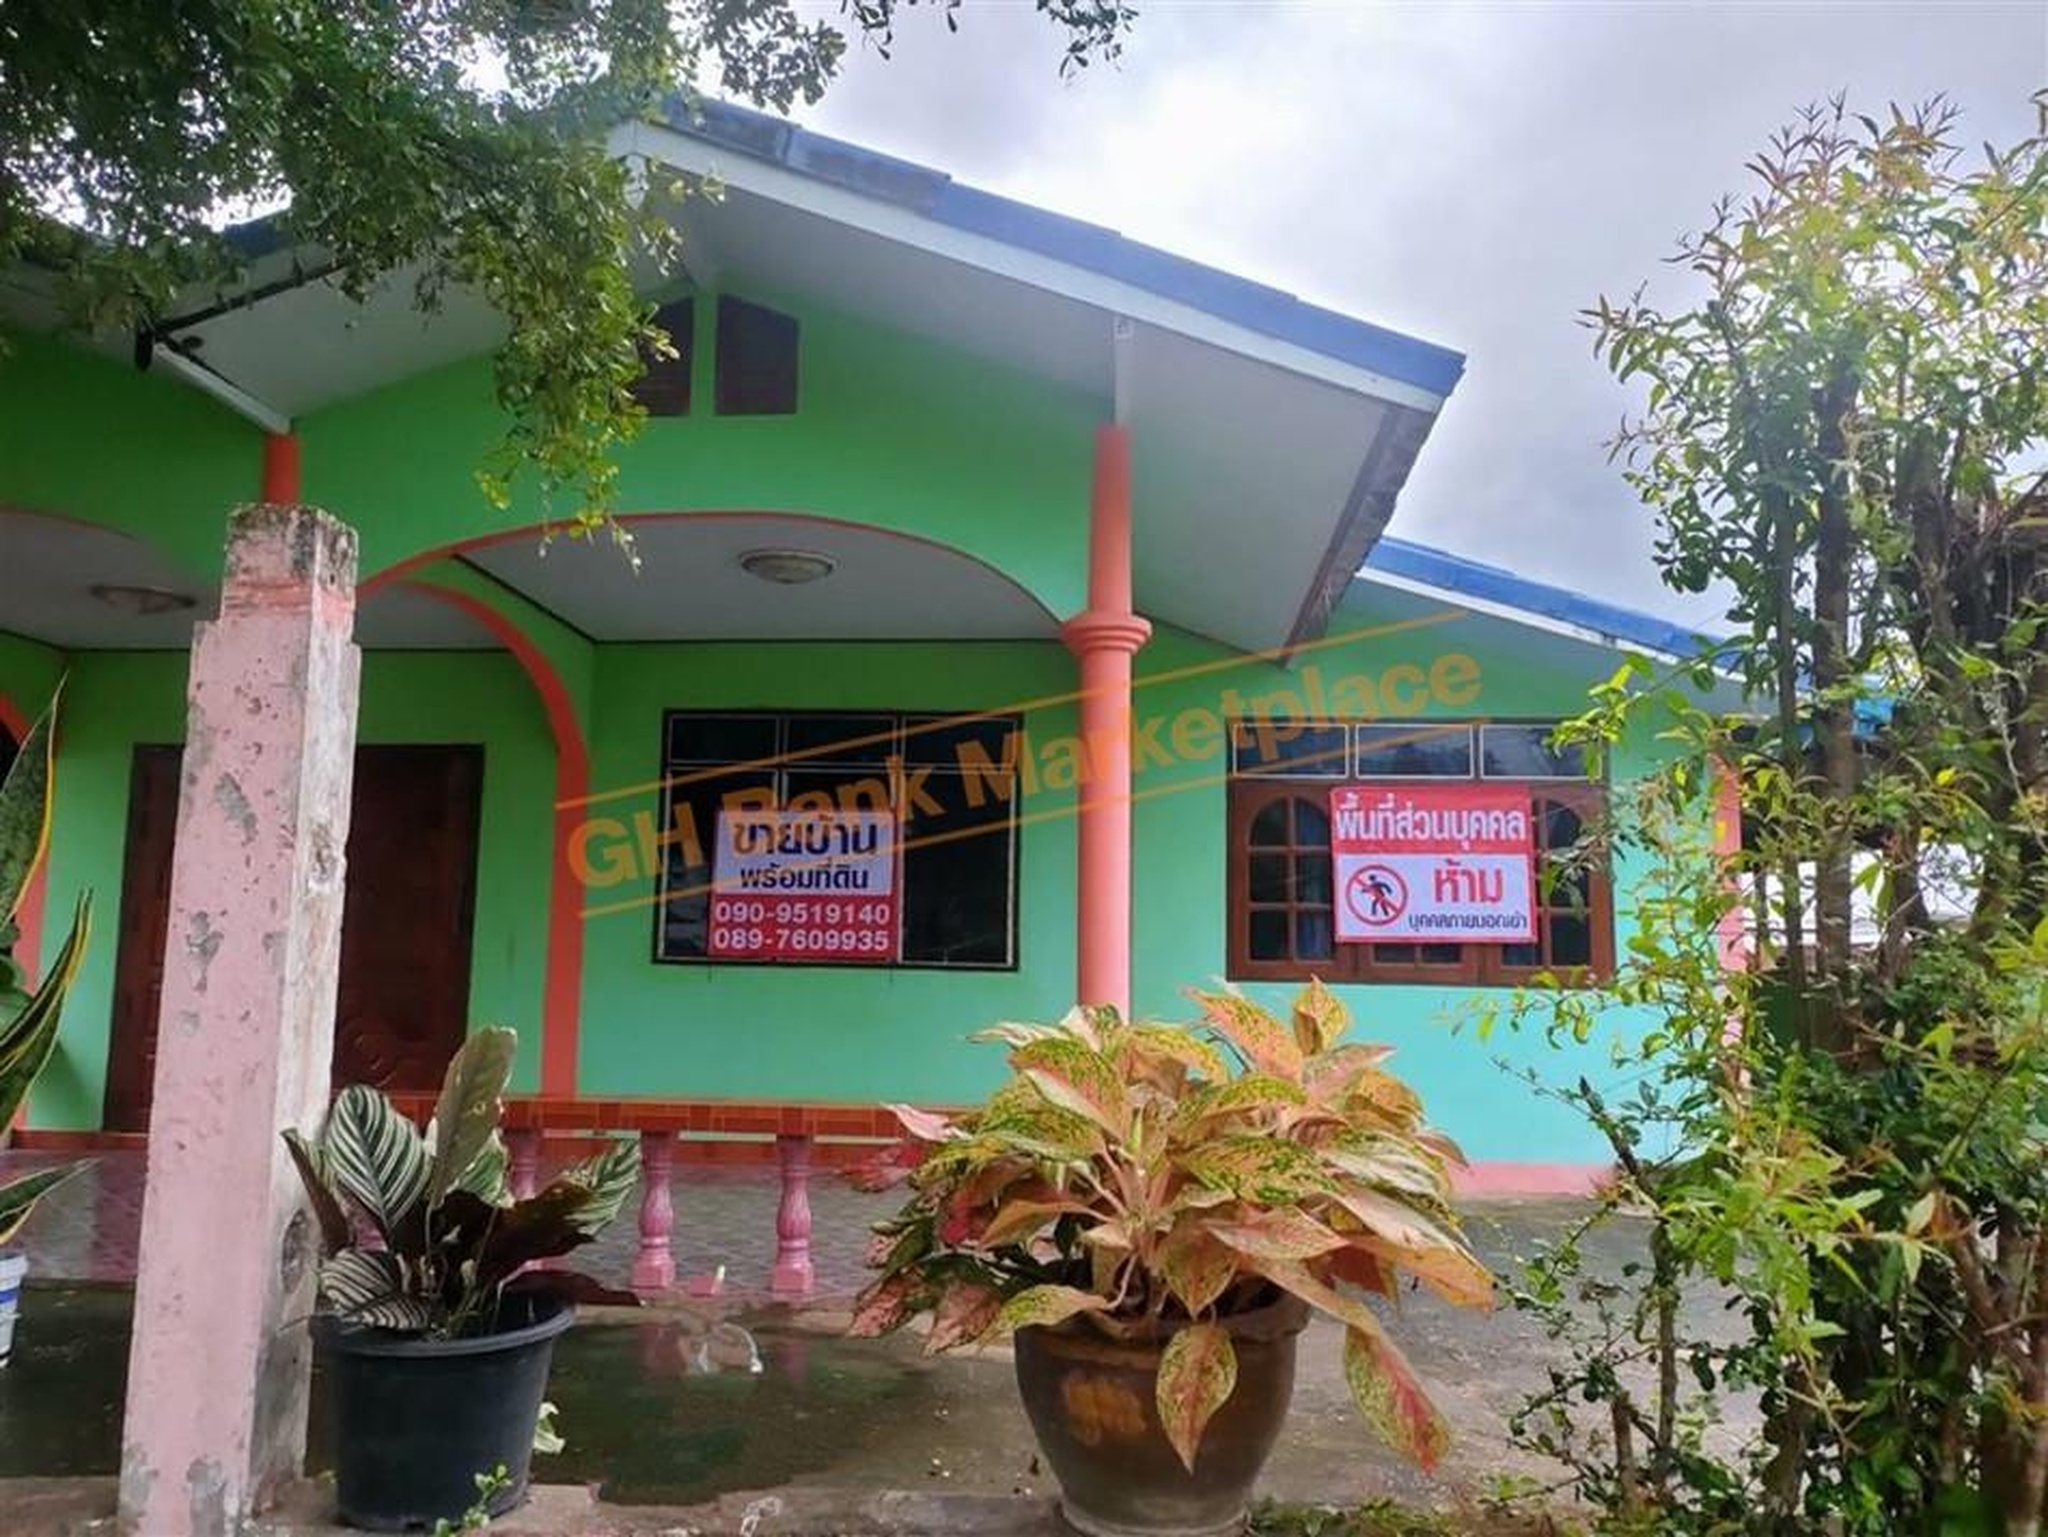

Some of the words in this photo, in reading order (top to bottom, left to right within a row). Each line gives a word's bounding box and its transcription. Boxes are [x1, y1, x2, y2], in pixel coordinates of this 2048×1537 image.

[733, 814, 877, 855] ขายบ้าน
[1335, 792, 1526, 851] พื้นที่ส่วนบุคคล
[740, 858, 869, 889] พร้อมที่ดิน
[1433, 858, 1503, 903] ห้าม
[715, 903, 890, 924] 090-9519140
[714, 929, 889, 950] 089-7609935
